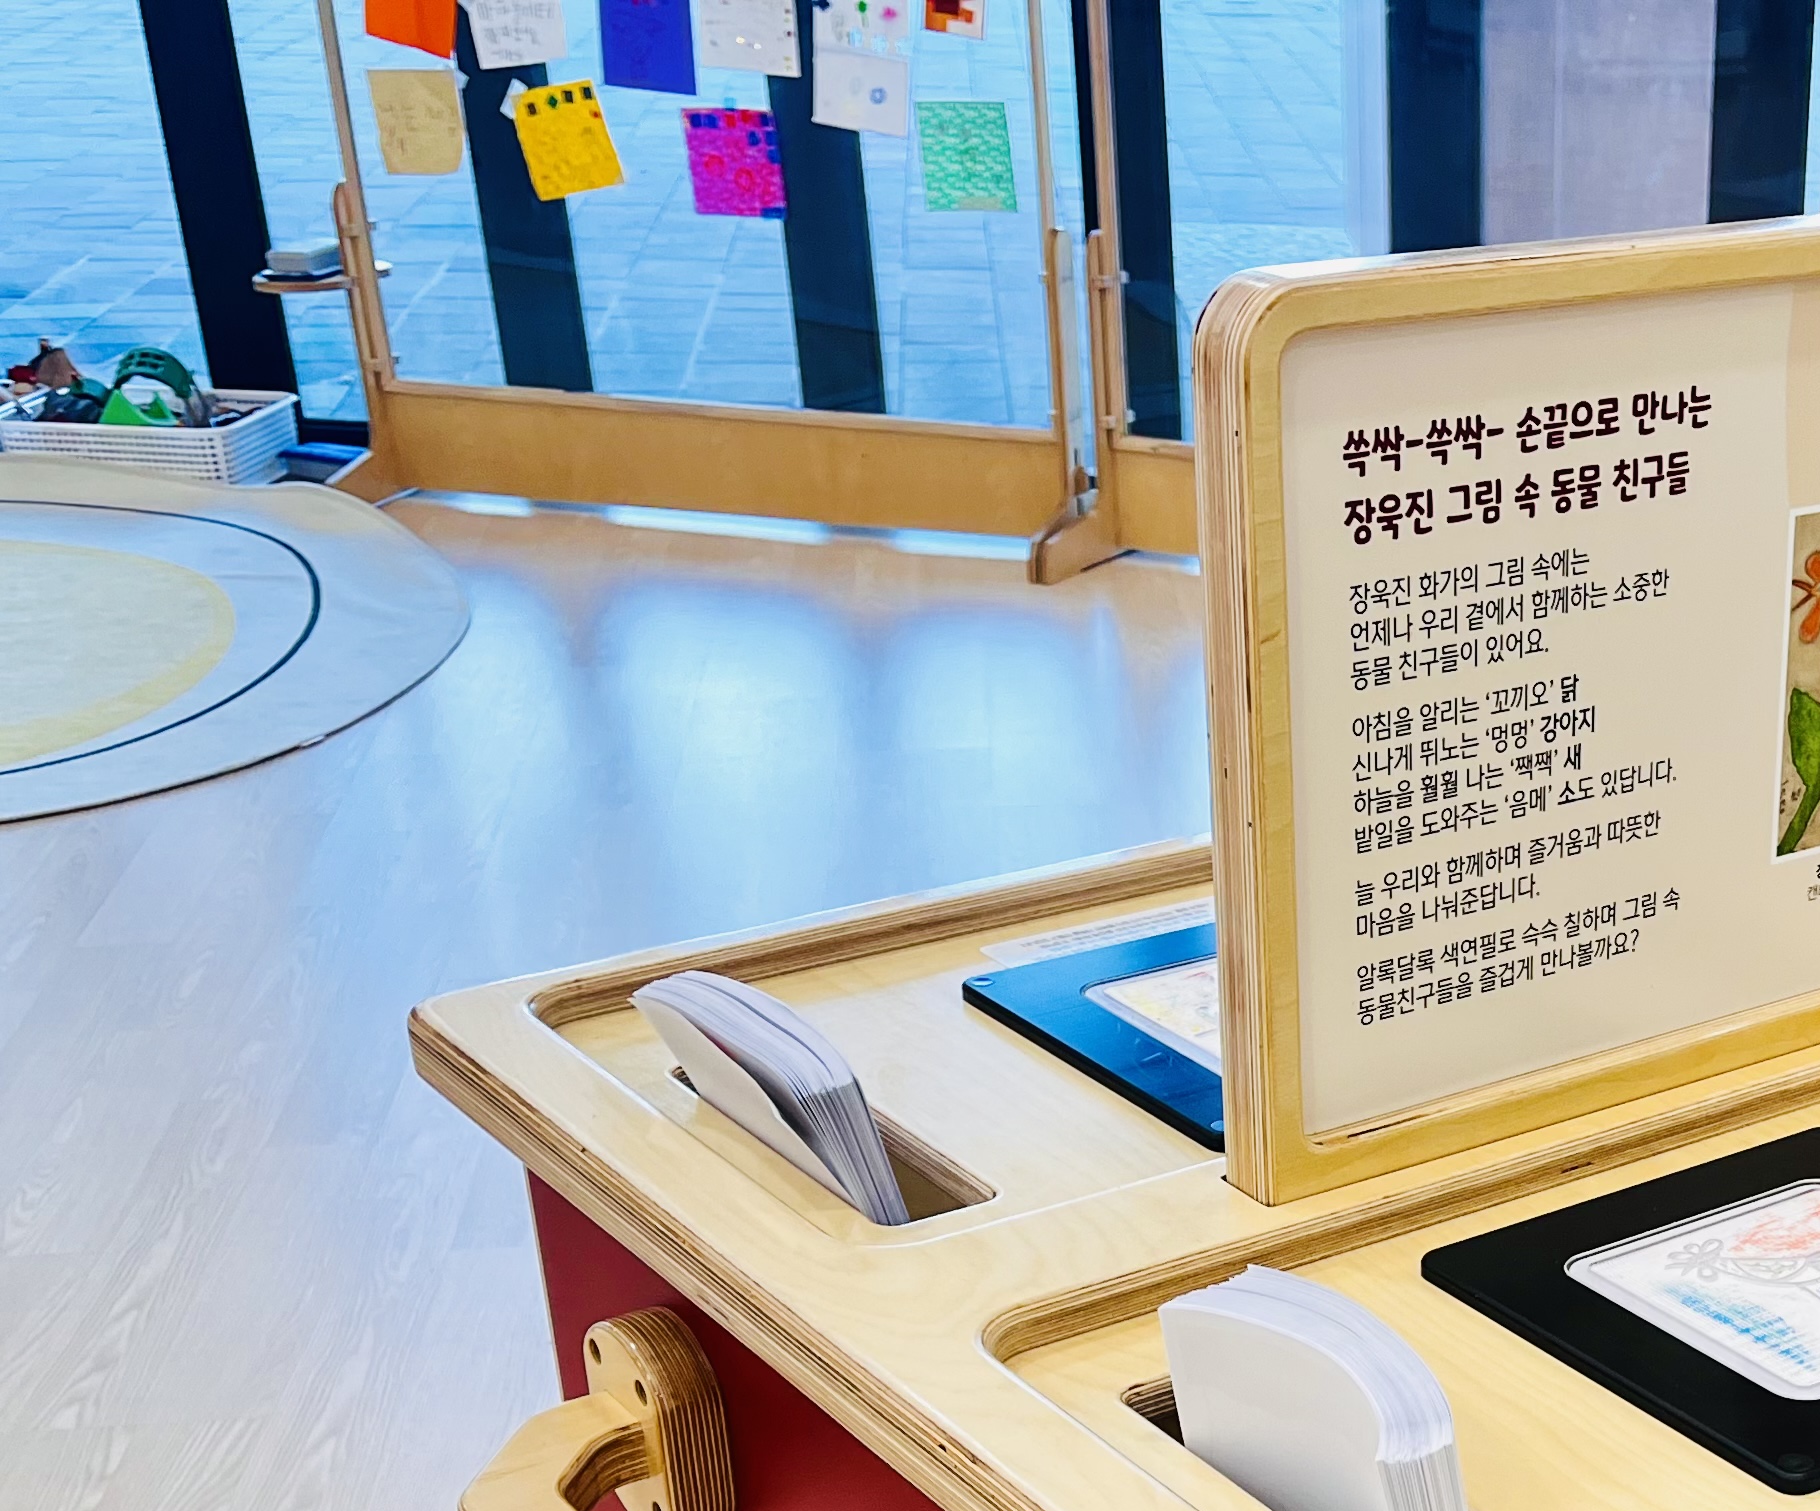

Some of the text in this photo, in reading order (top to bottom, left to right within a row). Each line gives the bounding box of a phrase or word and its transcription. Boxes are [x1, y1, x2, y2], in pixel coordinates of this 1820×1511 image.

[1516, 397, 1620, 453] 손끝으로
[1632, 385, 1712, 435] 만나는
[1344, 451, 1690, 545] 장욱진 그림 속 동물 친구들
[1349, 548, 1590, 614] 장욱진 화가의 그림 속에는
[1351, 568, 1669, 652] 언제나 우리 곁에서 함께하는 소중한
[1350, 629, 1548, 690] 동물 친구들이 있어요.
[1352, 707, 1413, 743] 아침을
[1420, 697, 1479, 732] 알리는
[1561, 674, 1579, 703] 닭
[1352, 743, 1412, 782] 신나게
[1420, 733, 1479, 767] 뛰노는
[1540, 705, 1595, 743] 강아지
[1354, 780, 1414, 816] 하늘을
[1420, 770, 1458, 804] 훨훨
[1467, 763, 1504, 791] 나는
[1563, 743, 1581, 770] 새
[1355, 816, 1414, 854] 밭일을
[1420, 799, 1498, 836] 도와주는
[1557, 777, 1595, 805] 소도
[1601, 758, 1676, 798] 있답니다.
[1355, 810, 1661, 906] 늘 우리와 함께하며 즐거움과 따뜻한
[1357, 873, 1540, 938] 마음을 나눠준답니다.
[1357, 887, 1680, 992] 알록달록 색연필로 슥슥 칠하며 그림 속
[1357, 929, 1639, 1025] 동물친구들을 즐겁게 만나볼까요?
